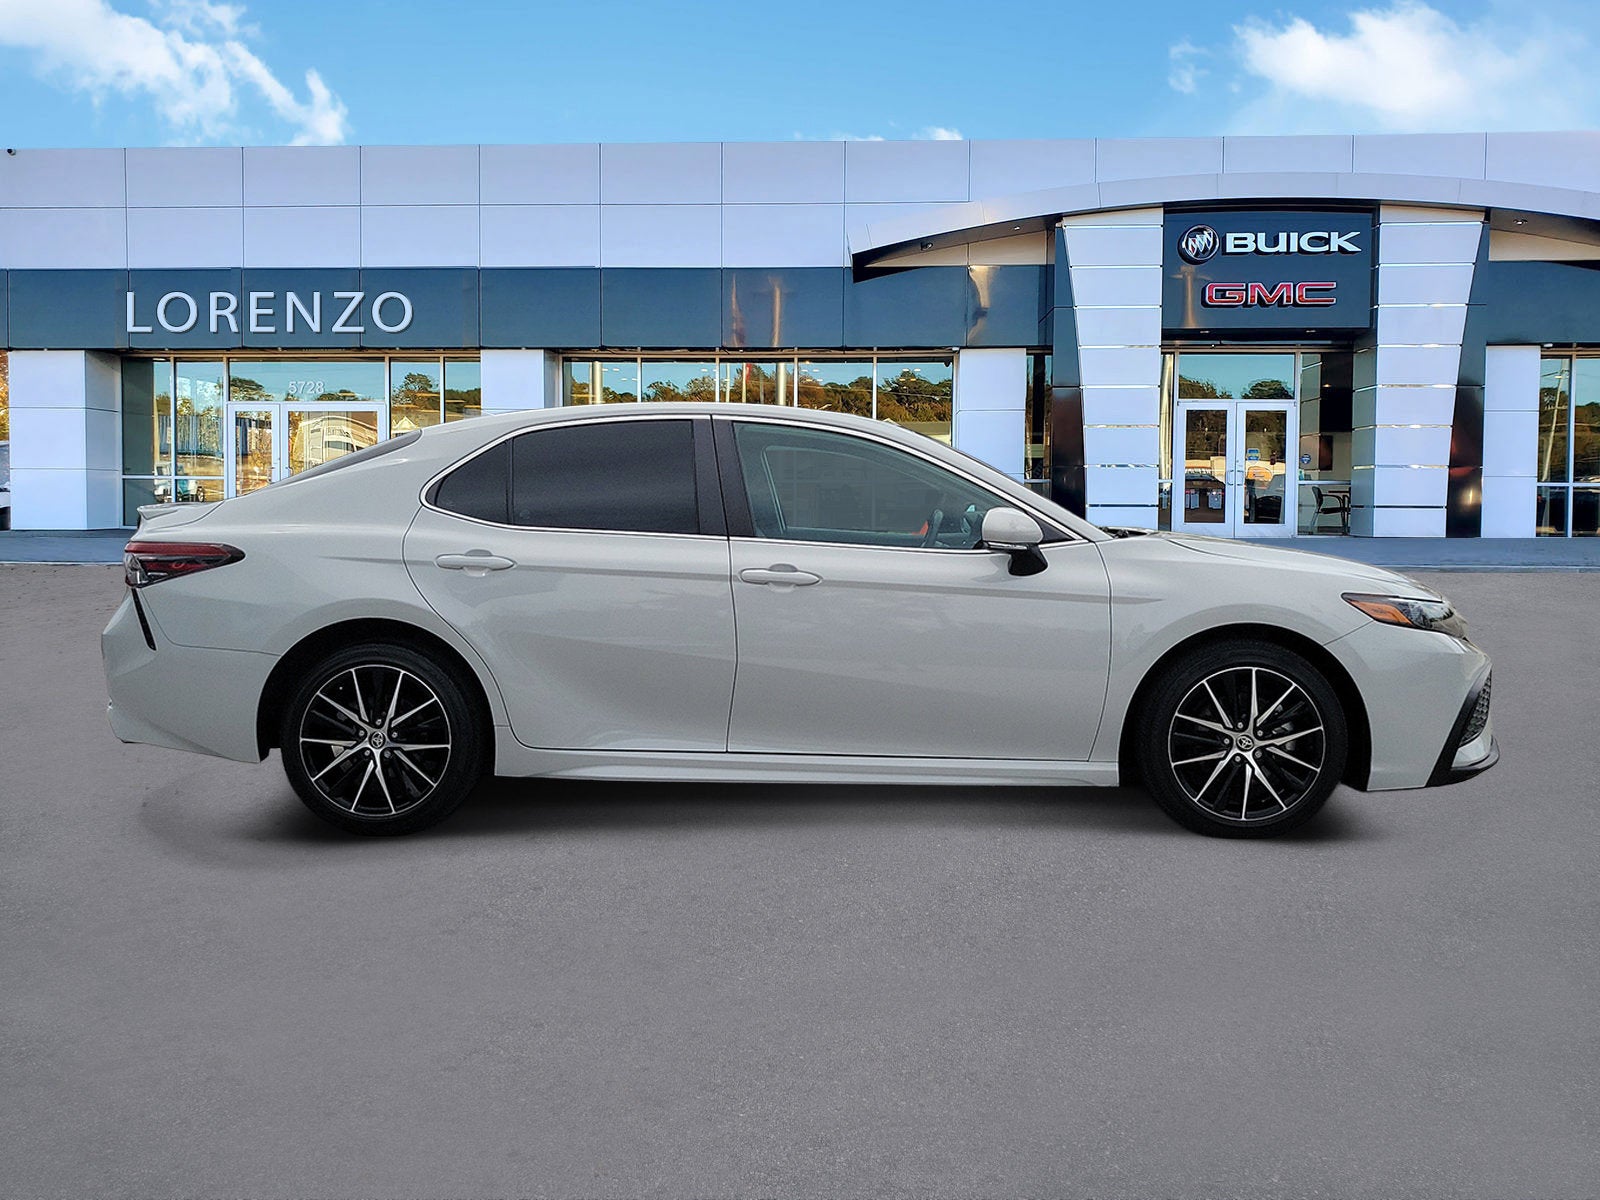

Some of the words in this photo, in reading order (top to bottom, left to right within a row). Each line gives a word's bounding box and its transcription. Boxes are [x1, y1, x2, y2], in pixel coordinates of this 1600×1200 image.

[1225, 231, 1362, 253] BUICK
[1204, 281, 1337, 306] GMC
[126, 291, 414, 333] LORENZO
[288, 381, 325, 394] 5728
